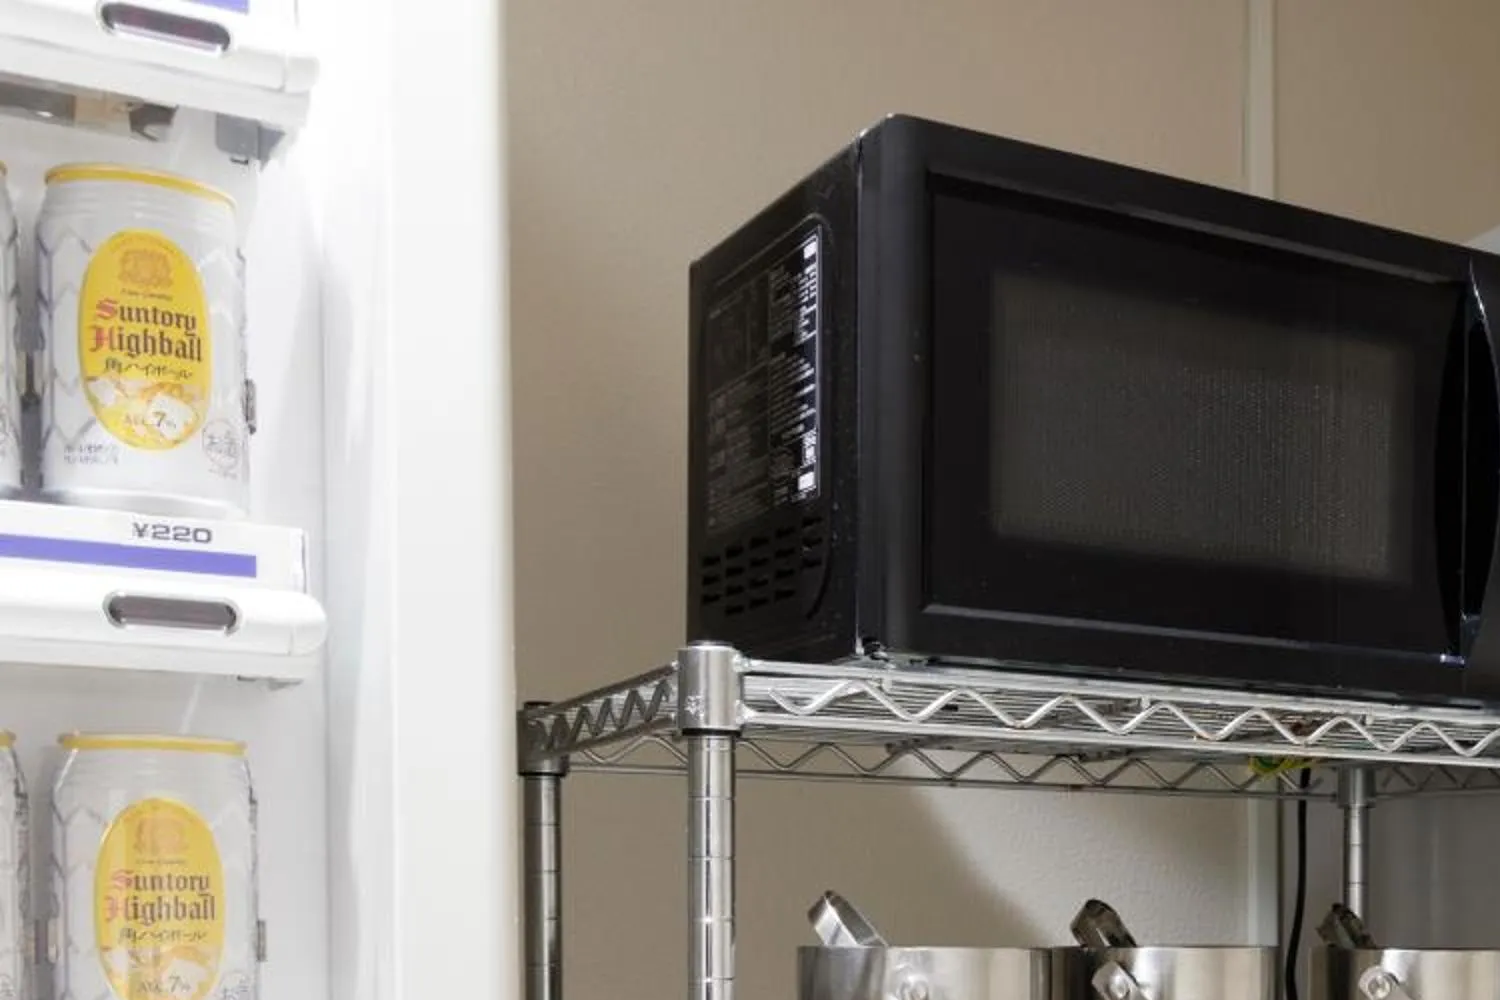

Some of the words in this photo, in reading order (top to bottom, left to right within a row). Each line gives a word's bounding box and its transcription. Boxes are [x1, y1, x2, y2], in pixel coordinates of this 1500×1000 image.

[95, 297, 197, 337] Suntory
[88, 324, 202, 363] Highball
[132, 522, 213, 544] ¥220
[111, 868, 211, 898] Suntory
[104, 894, 216, 927] Highball
